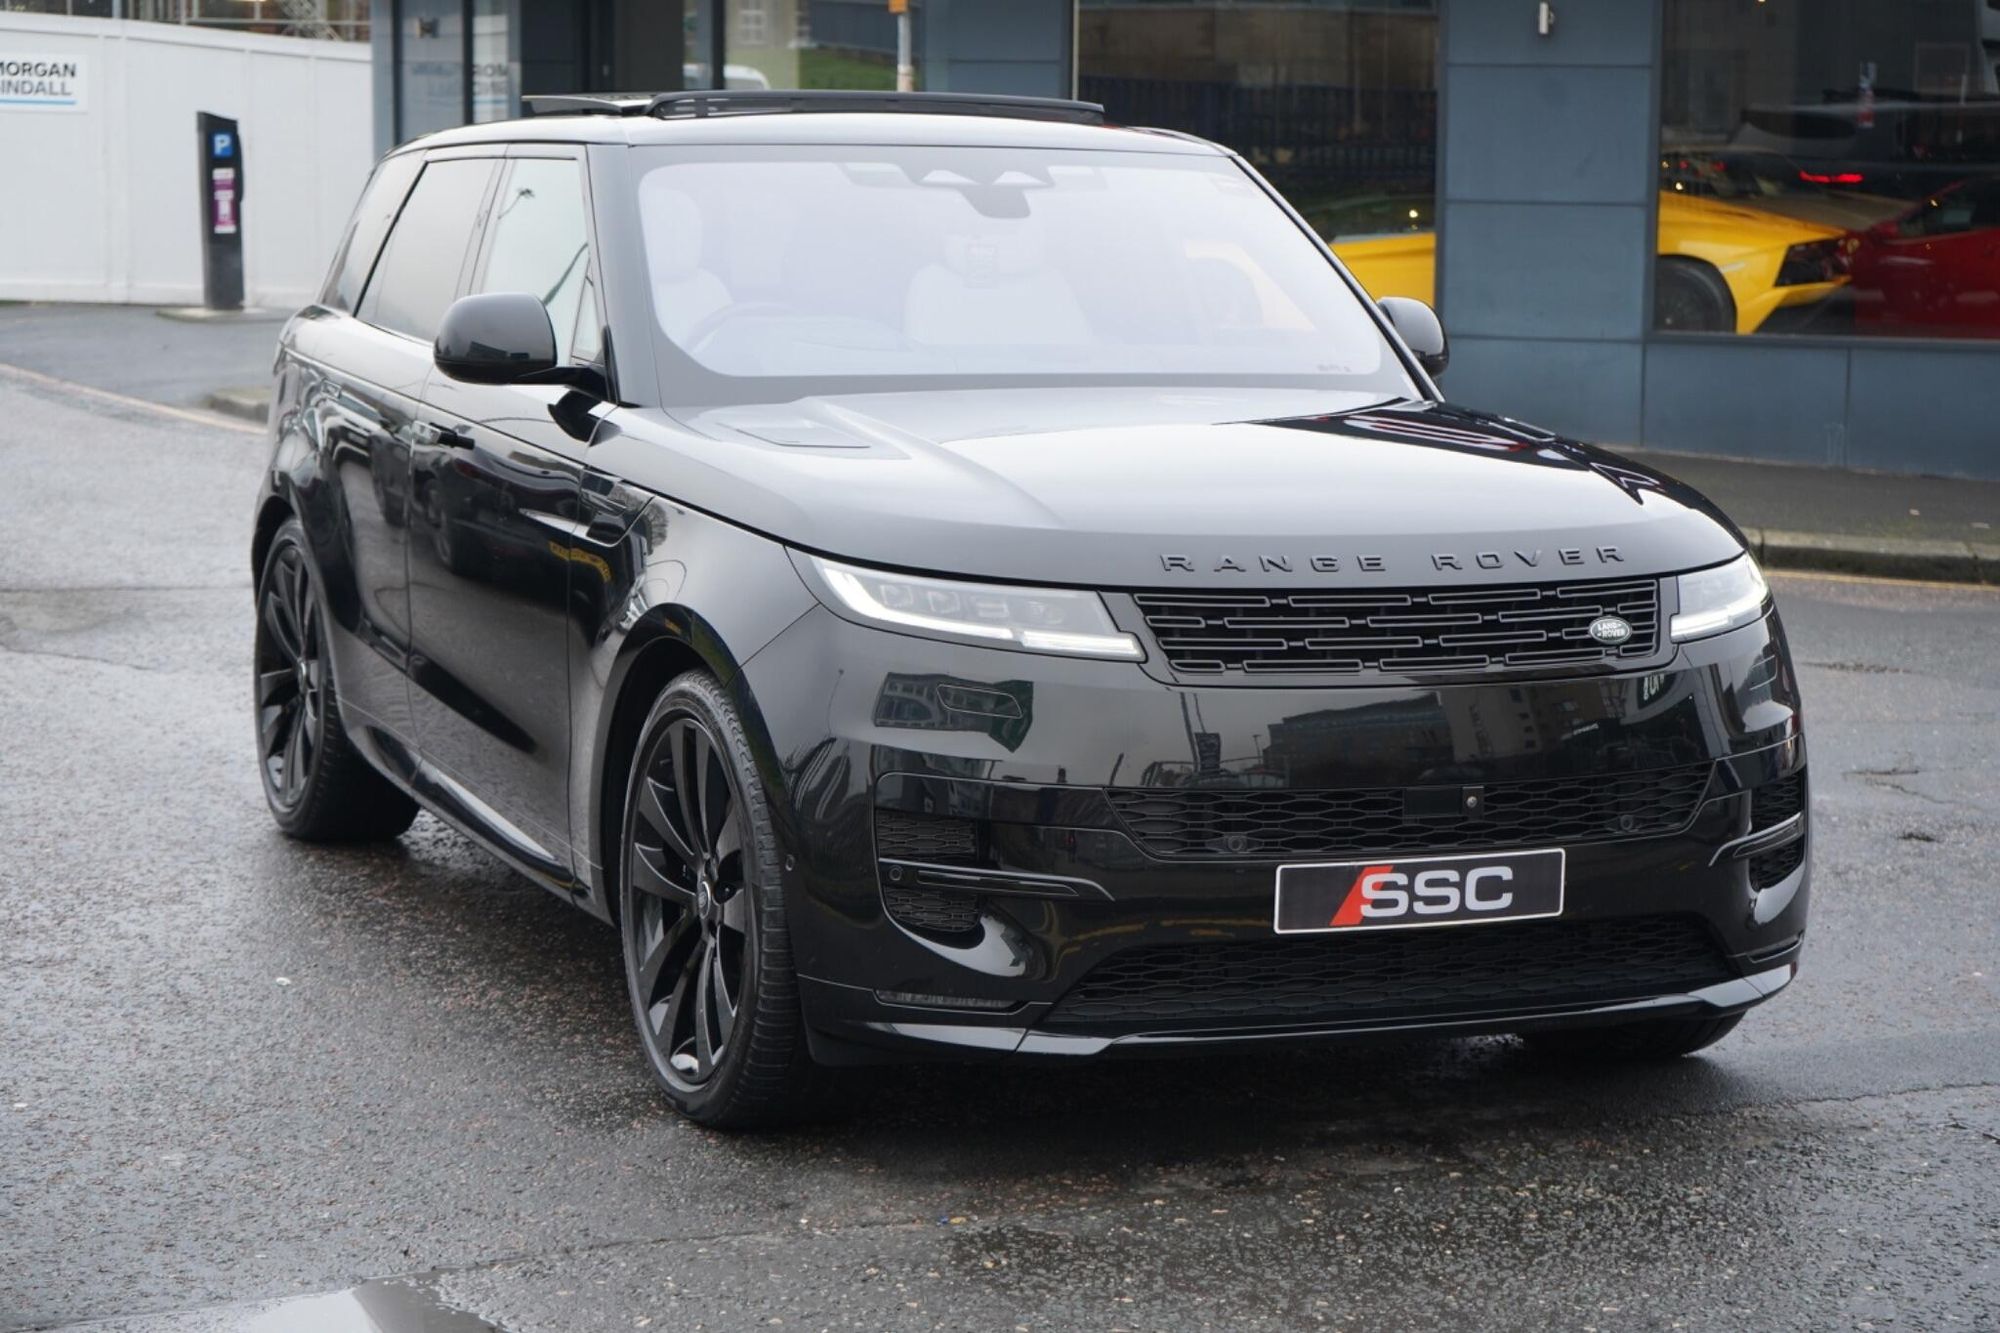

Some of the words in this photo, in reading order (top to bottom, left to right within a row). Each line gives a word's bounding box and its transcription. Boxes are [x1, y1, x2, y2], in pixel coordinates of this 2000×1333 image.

[0, 61, 76, 77] ORGAN
[0, 80, 72, 95] INDALL
[214, 134, 231, 155] P
[1161, 553, 1386, 573] RANGE
[1431, 546, 1625, 571] ROVER
[1360, 866, 1513, 918] SSC
